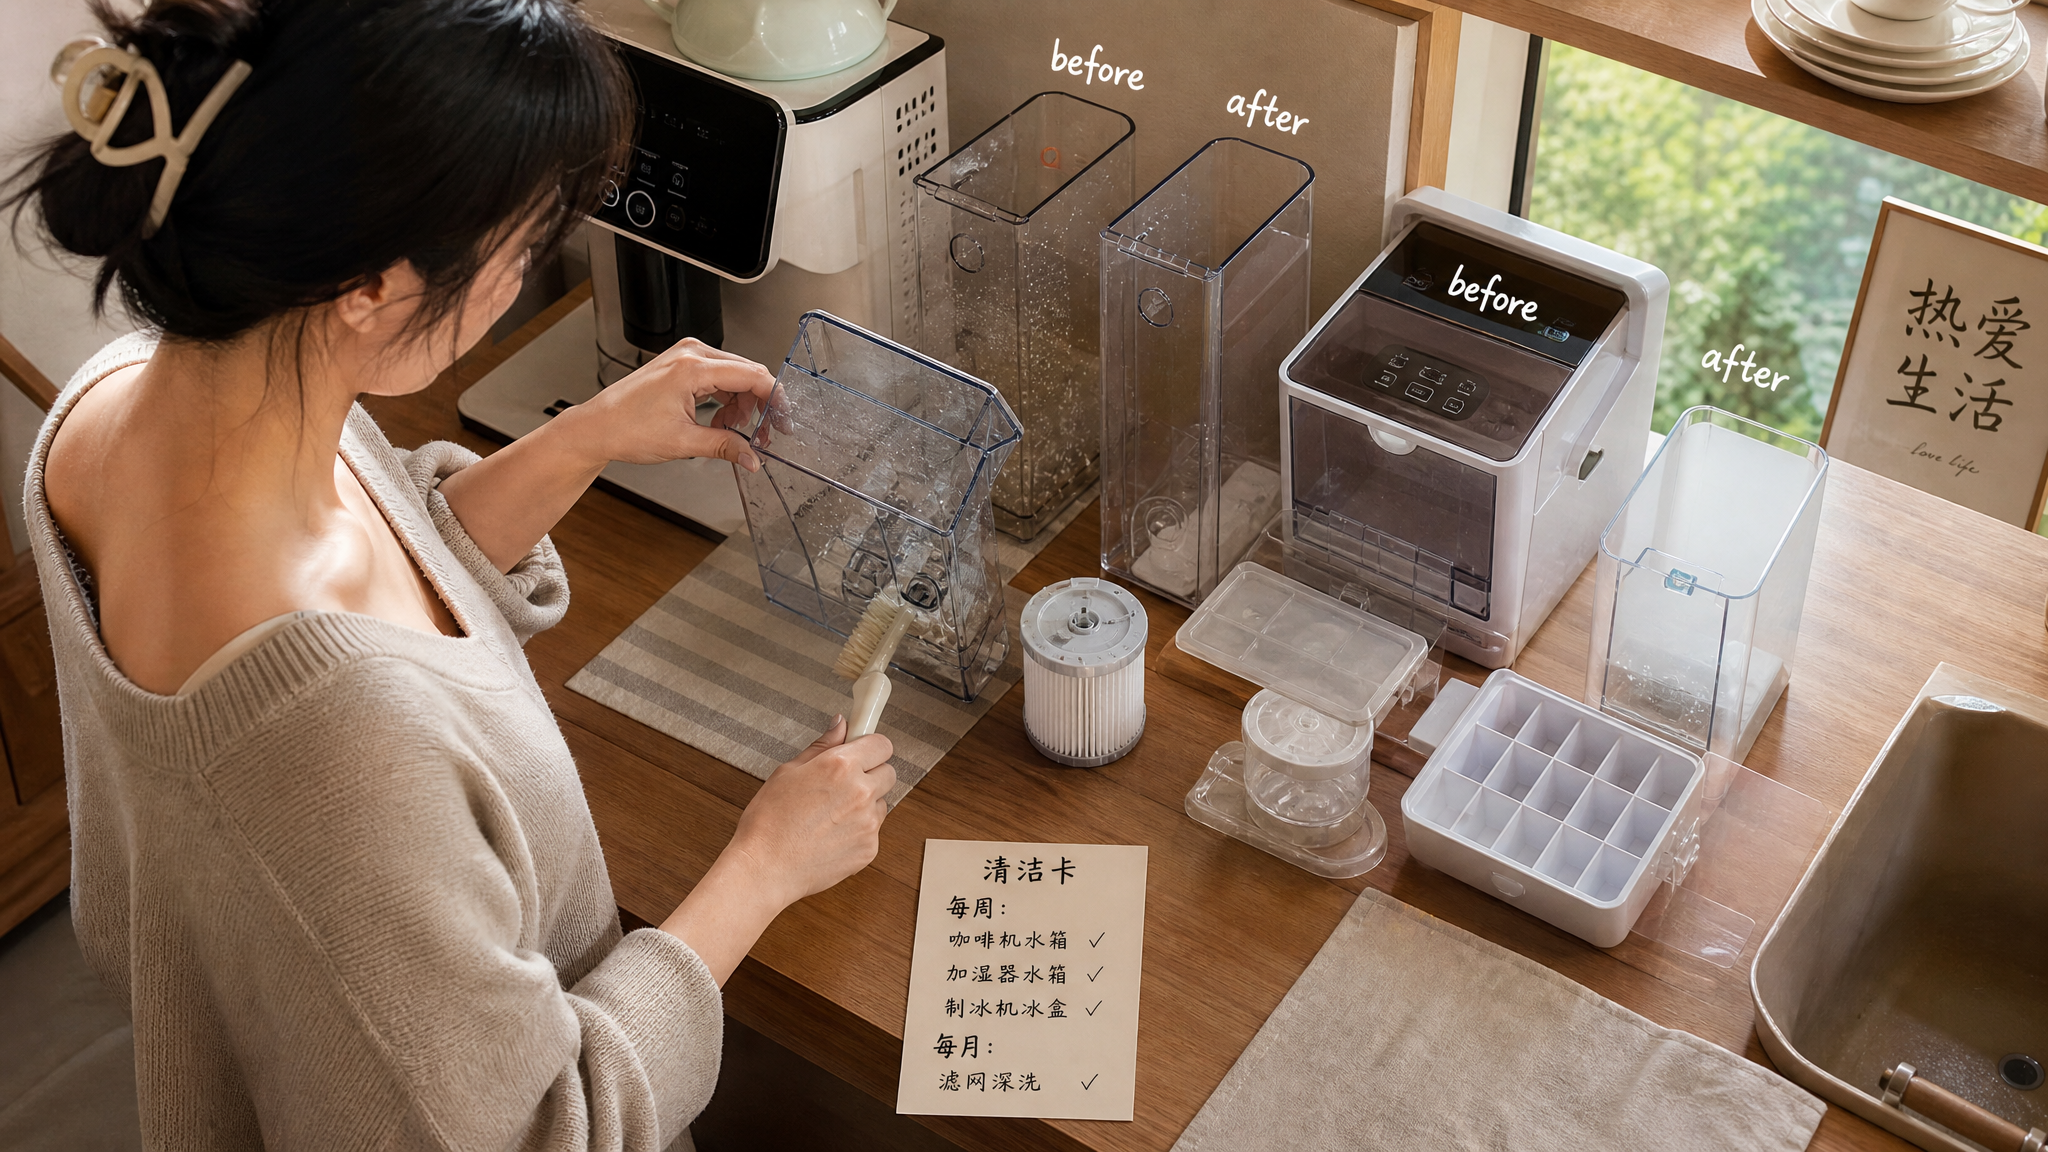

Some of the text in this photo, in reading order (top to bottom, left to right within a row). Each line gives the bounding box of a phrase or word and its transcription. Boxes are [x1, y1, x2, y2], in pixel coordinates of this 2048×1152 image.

[1905, 278, 2031, 369] 热爱
[1886, 353, 2014, 432] 生活
[1948, 454, 1980, 477] life
[983, 855, 1077, 885] 清洁卡
[949, 930, 1067, 950] 咖啡机水箱
[946, 964, 1066, 985] 加湿器水箱
[944, 997, 1068, 1019] 制冰机冰盒
[938, 1069, 1041, 1093] 滤网深洗
